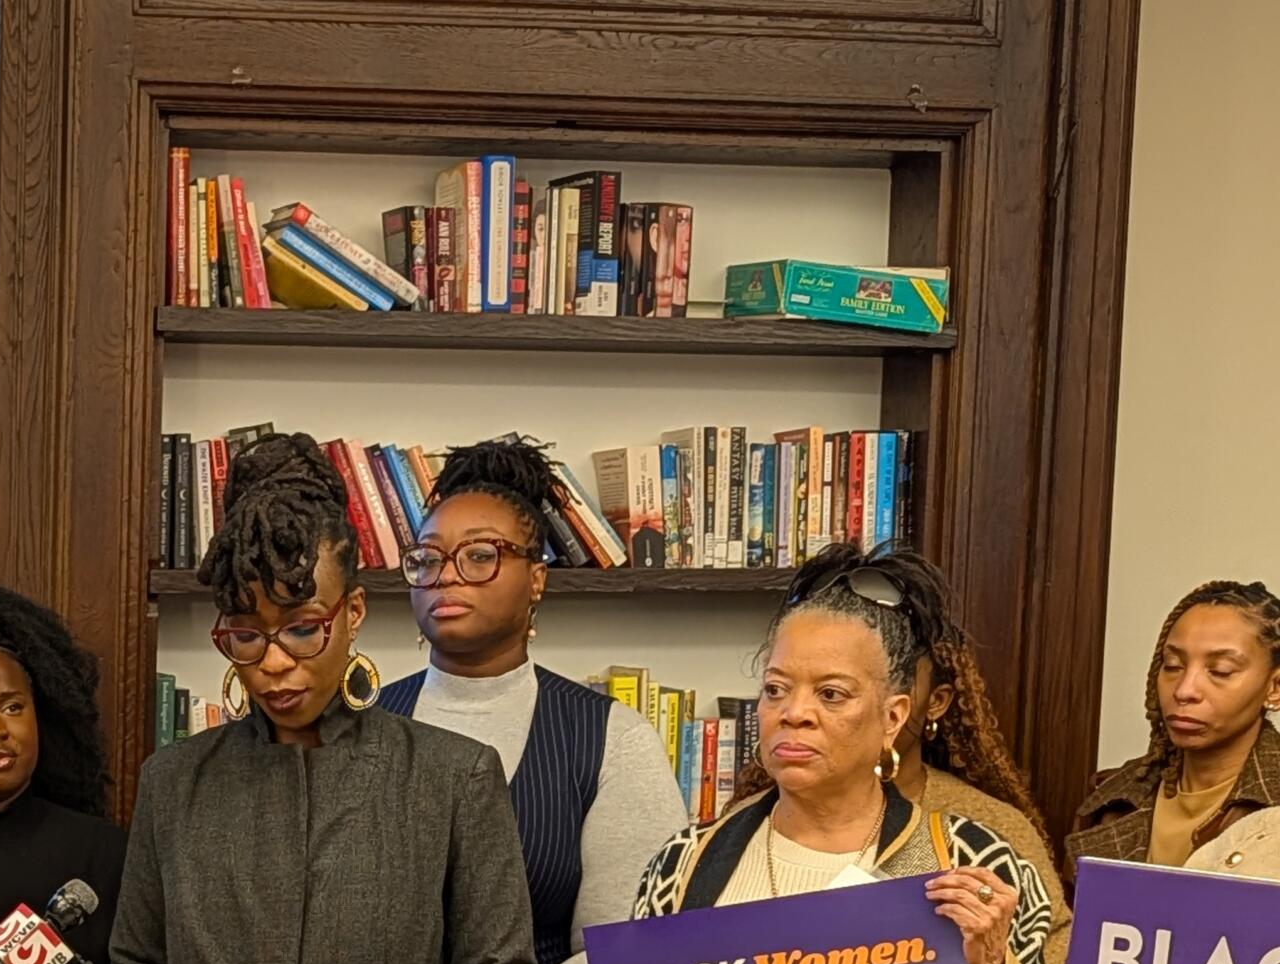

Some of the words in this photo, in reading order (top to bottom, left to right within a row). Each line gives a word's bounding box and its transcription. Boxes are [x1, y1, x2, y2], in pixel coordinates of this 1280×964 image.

[439, 221, 450, 237] ANN
[598, 222, 613, 255] REPORT
[438, 238, 450, 256] RULE
[841, 297, 869, 310] FAMILY
[871, 302, 905, 314] EDITION
[731, 428, 741, 480] FANTASY
[201, 461, 209, 482] WATER
[0, 920, 36, 953] WCVB
